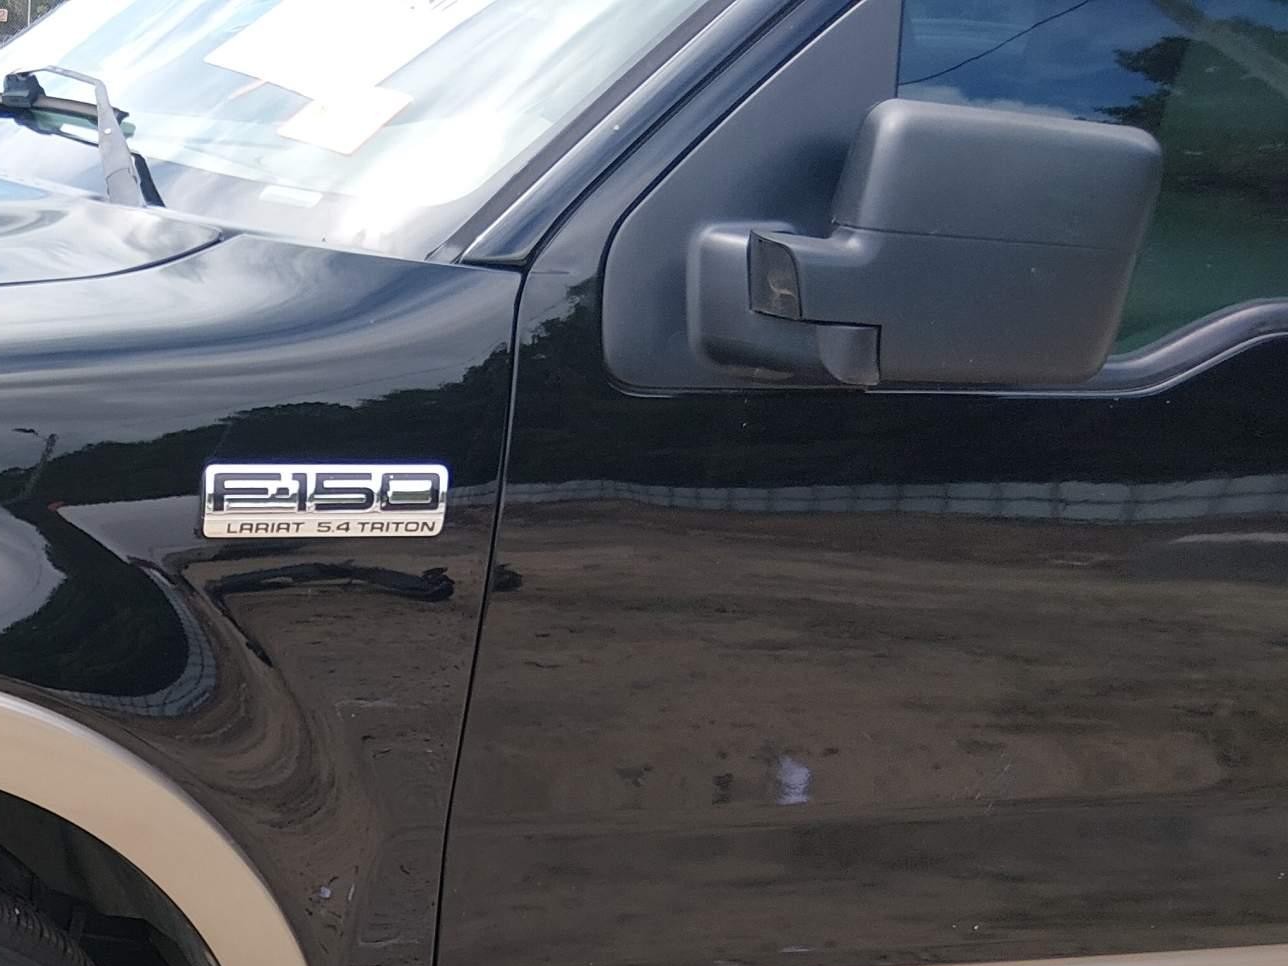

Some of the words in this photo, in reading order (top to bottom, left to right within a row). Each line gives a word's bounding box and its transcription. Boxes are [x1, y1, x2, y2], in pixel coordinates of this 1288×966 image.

[213, 472, 441, 512] F-150
[226, 521, 306, 534] LARIAT
[315, 520, 351, 533] 5.4
[357, 520, 437, 533] TRITON
